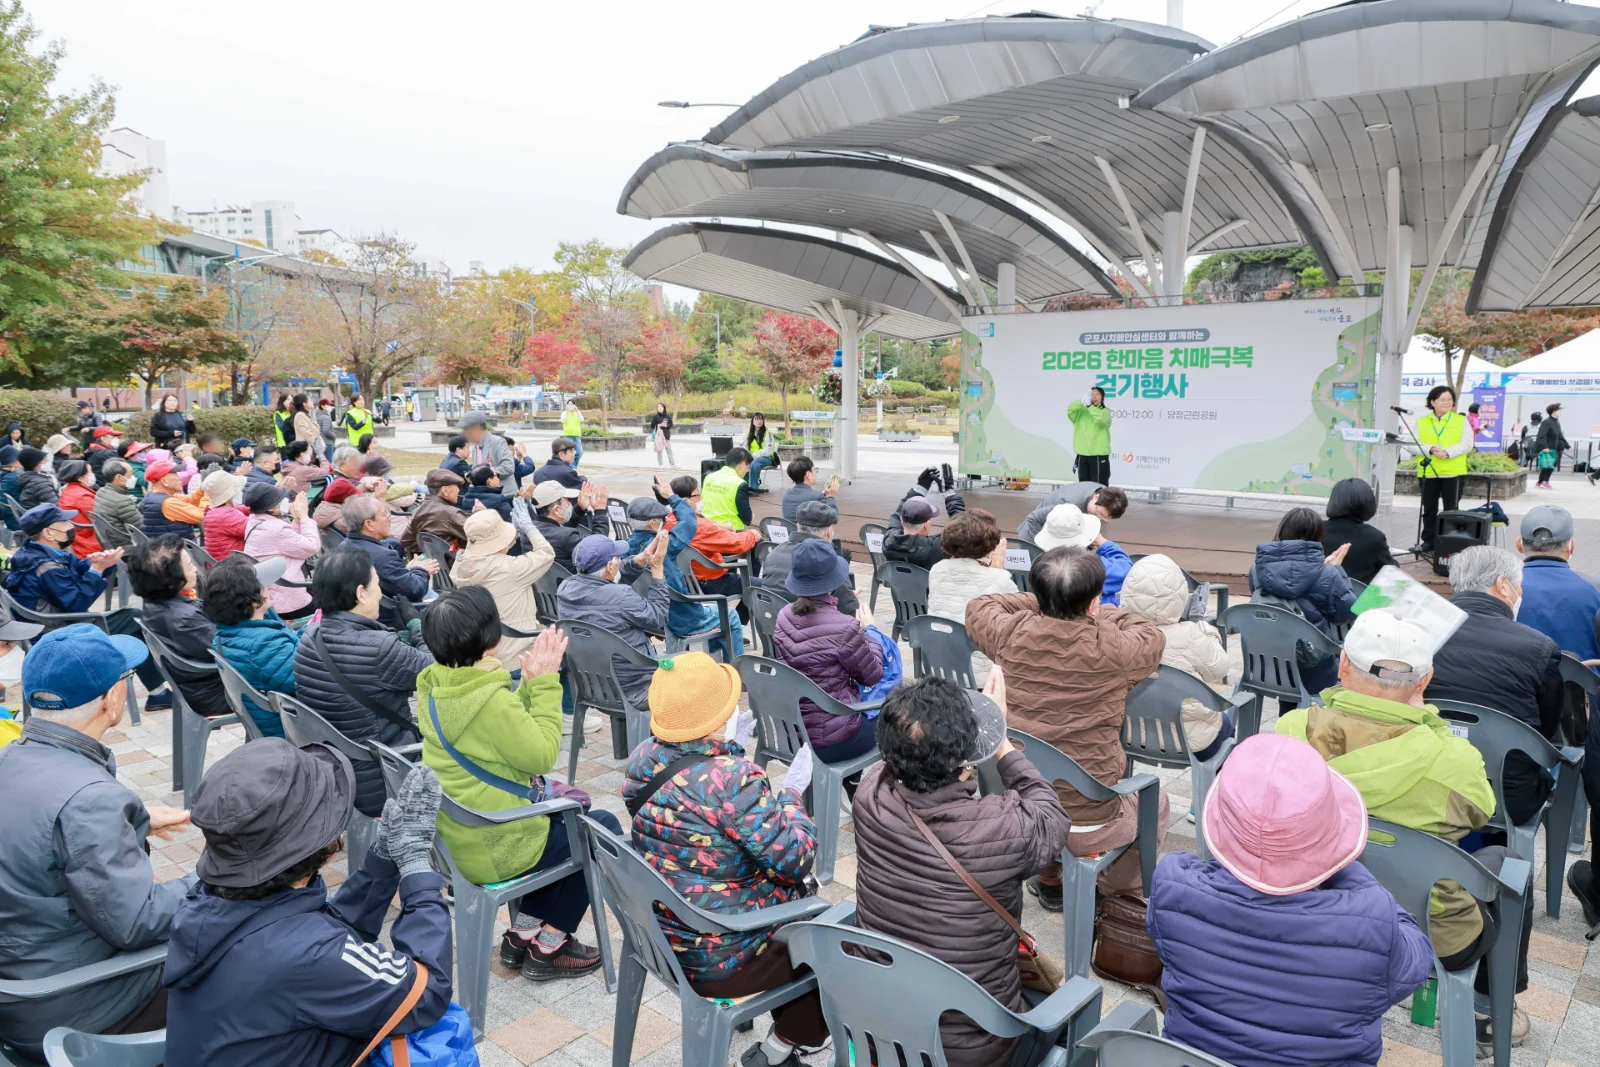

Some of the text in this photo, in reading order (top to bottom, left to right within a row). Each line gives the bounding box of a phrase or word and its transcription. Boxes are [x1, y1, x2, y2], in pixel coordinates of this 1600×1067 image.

[1084, 330, 1204, 343] 군포시치매안심센터와 함께하는
[1042, 346, 1254, 370] 2026 한마음 치매극복
[1095, 373, 1189, 399] 걷기행사
[1413, 377, 1436, 387] 검사
[1110, 409, 1154, 419] 0:00~12:00
